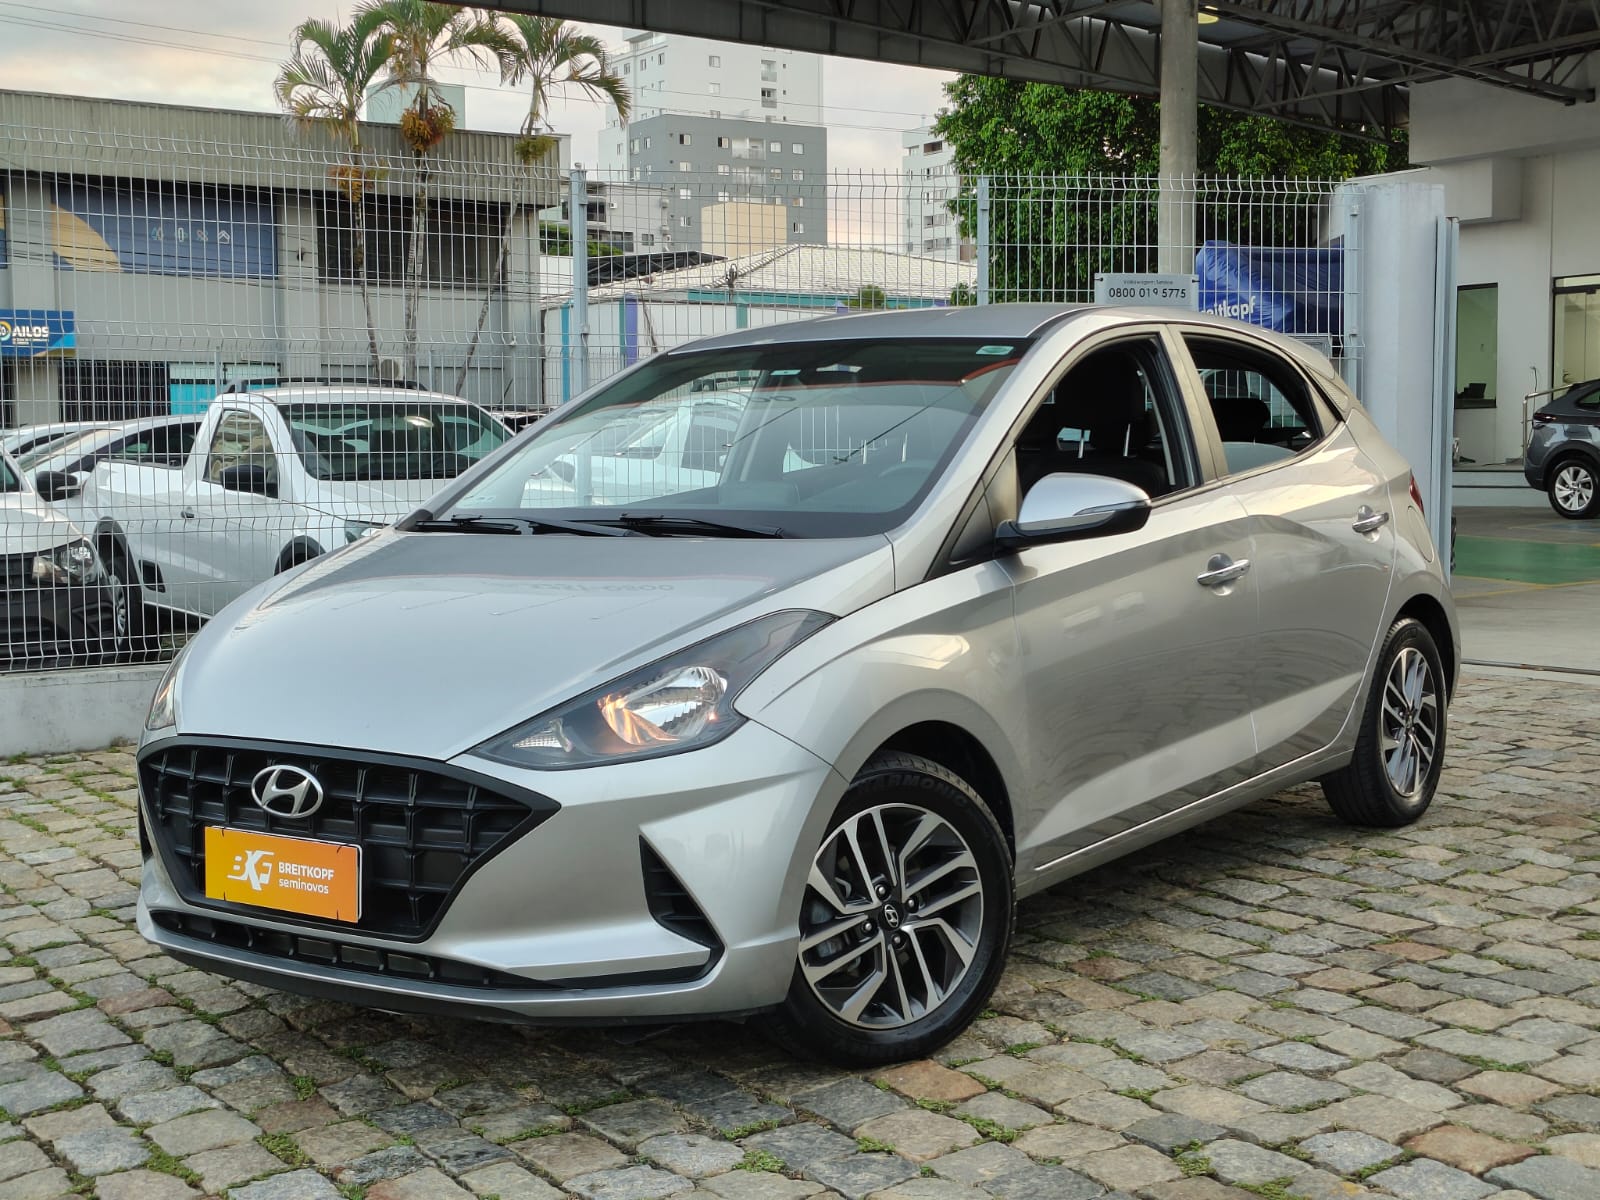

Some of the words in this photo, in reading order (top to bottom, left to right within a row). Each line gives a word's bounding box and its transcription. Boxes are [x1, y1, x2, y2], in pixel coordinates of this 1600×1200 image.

[1108, 287, 1136, 298] 0800
[1138, 287, 1159, 298] 019
[1161, 287, 1187, 299] 5775
[1200, 295, 1256, 320] eitkopf
[12, 326, 49, 338] AILOS
[278, 861, 335, 881] BREITKOPF
[278, 878, 329, 894] seminovos
